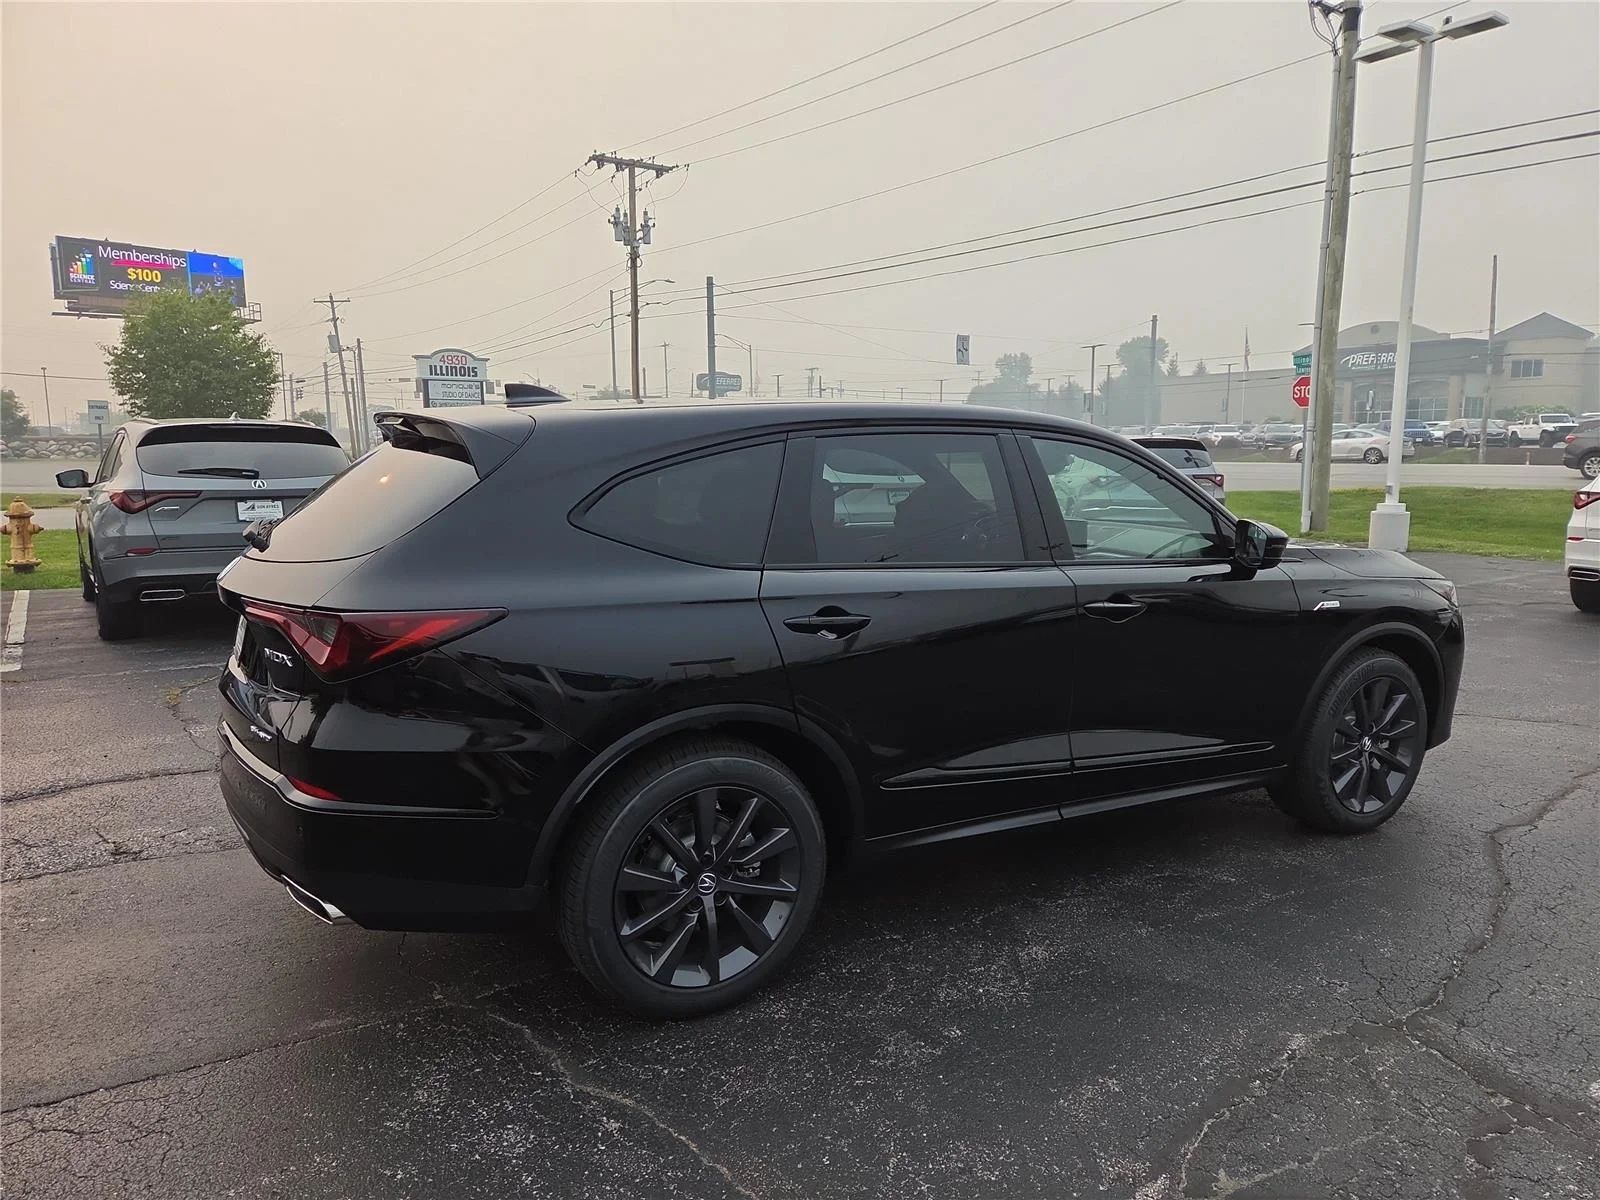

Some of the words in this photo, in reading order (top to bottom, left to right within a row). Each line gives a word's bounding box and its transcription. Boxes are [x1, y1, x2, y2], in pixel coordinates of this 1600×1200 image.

[98, 246, 186, 268] Memberships
[128, 268, 162, 282] $100
[440, 354, 468, 365] 4930
[428, 364, 478, 377] ILLINOIS
[442, 391, 457, 399] STUDIO
[1294, 386, 1310, 398] STO
